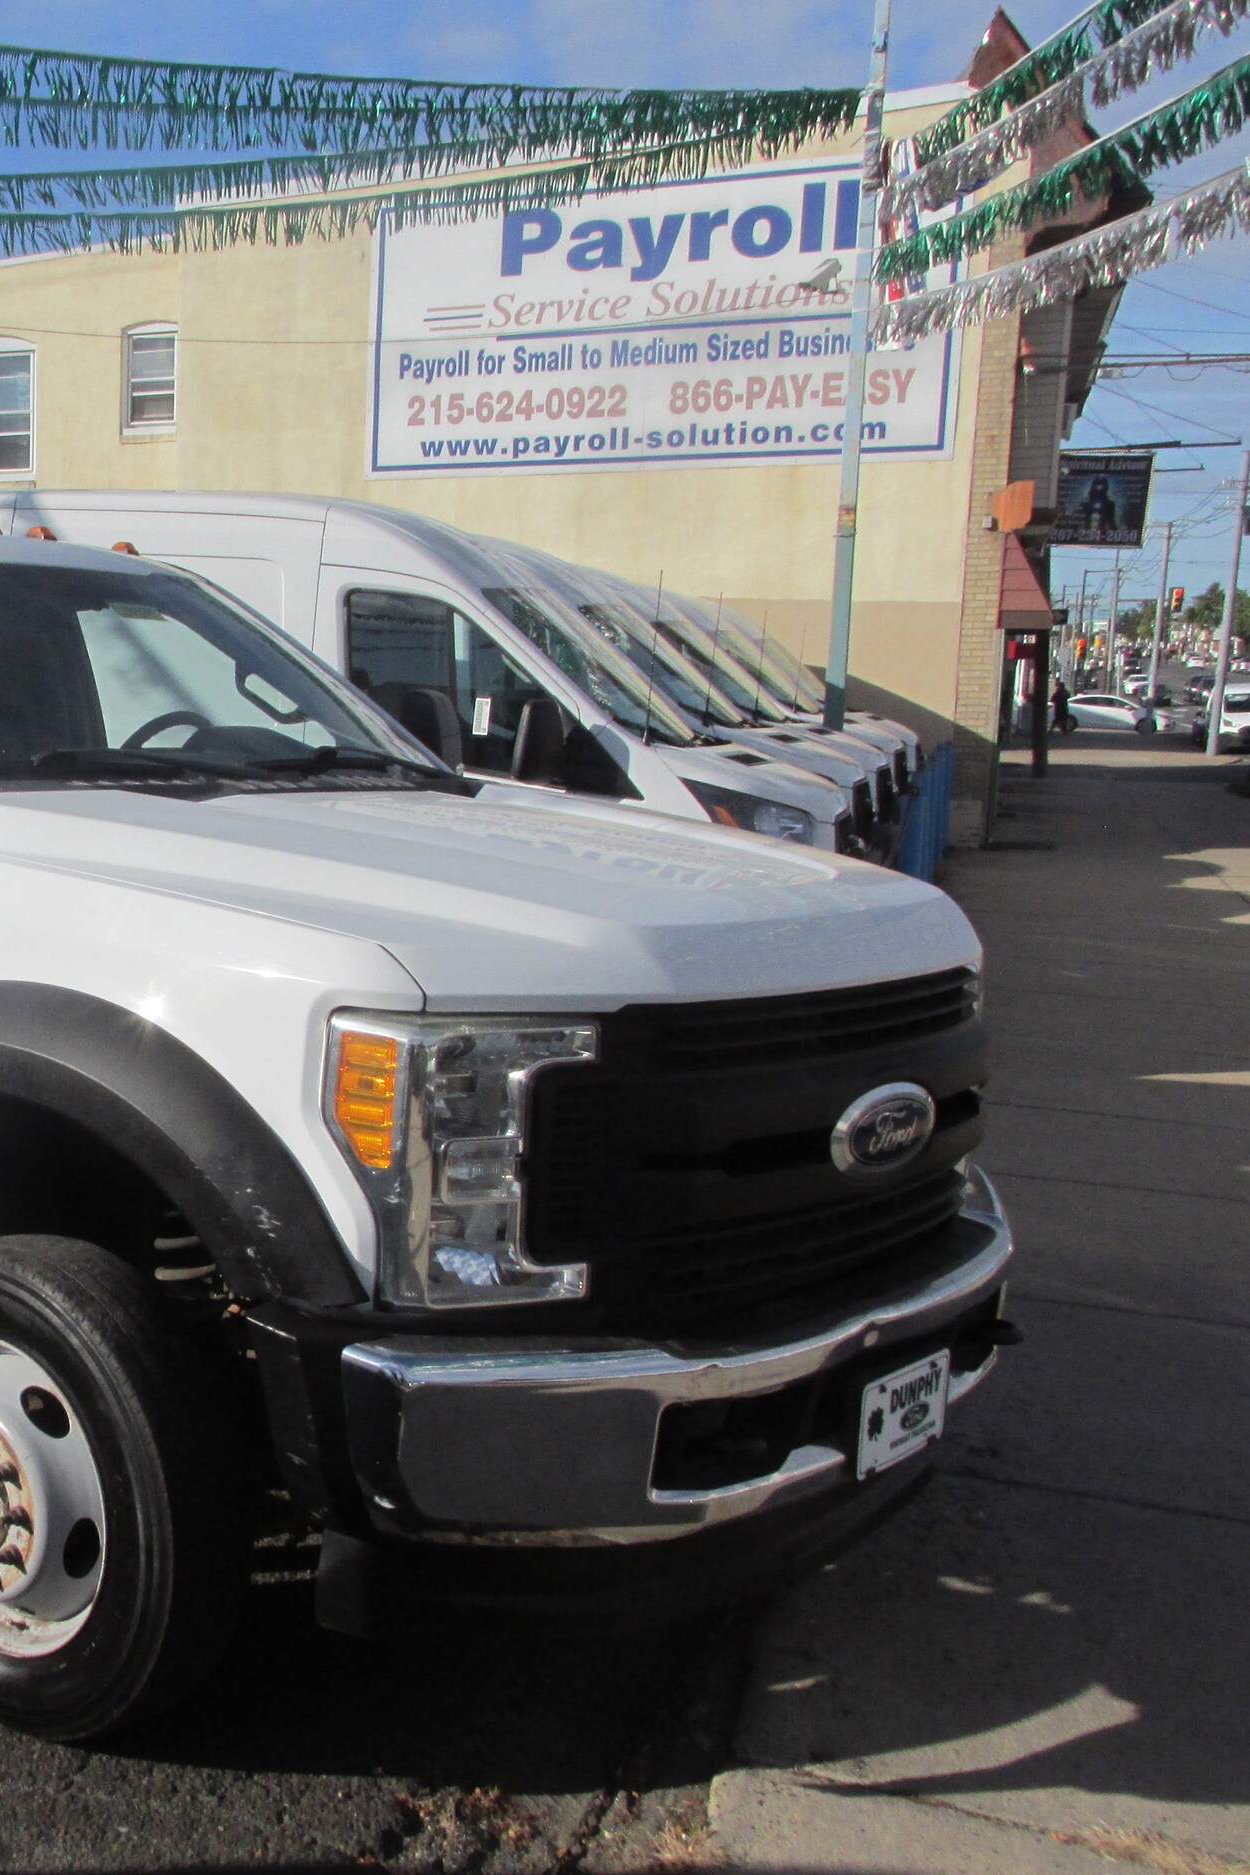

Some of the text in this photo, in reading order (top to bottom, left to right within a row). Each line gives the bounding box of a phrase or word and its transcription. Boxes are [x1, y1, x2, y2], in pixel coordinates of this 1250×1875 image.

[500, 179, 860, 282] Payroll
[488, 275, 852, 329] Service Solutions
[399, 350, 469, 384] Payroll
[477, 349, 506, 376] for
[513, 343, 573, 373] Small
[580, 343, 602, 370] to
[610, 337, 698, 368] Medium
[706, 331, 770, 362] Sized
[407, 368, 916, 426] 215-624-0922 866-PAY-ESY
[869, 1109, 918, 1155] Ford
[890, 1367, 942, 1414] DUNPHY
